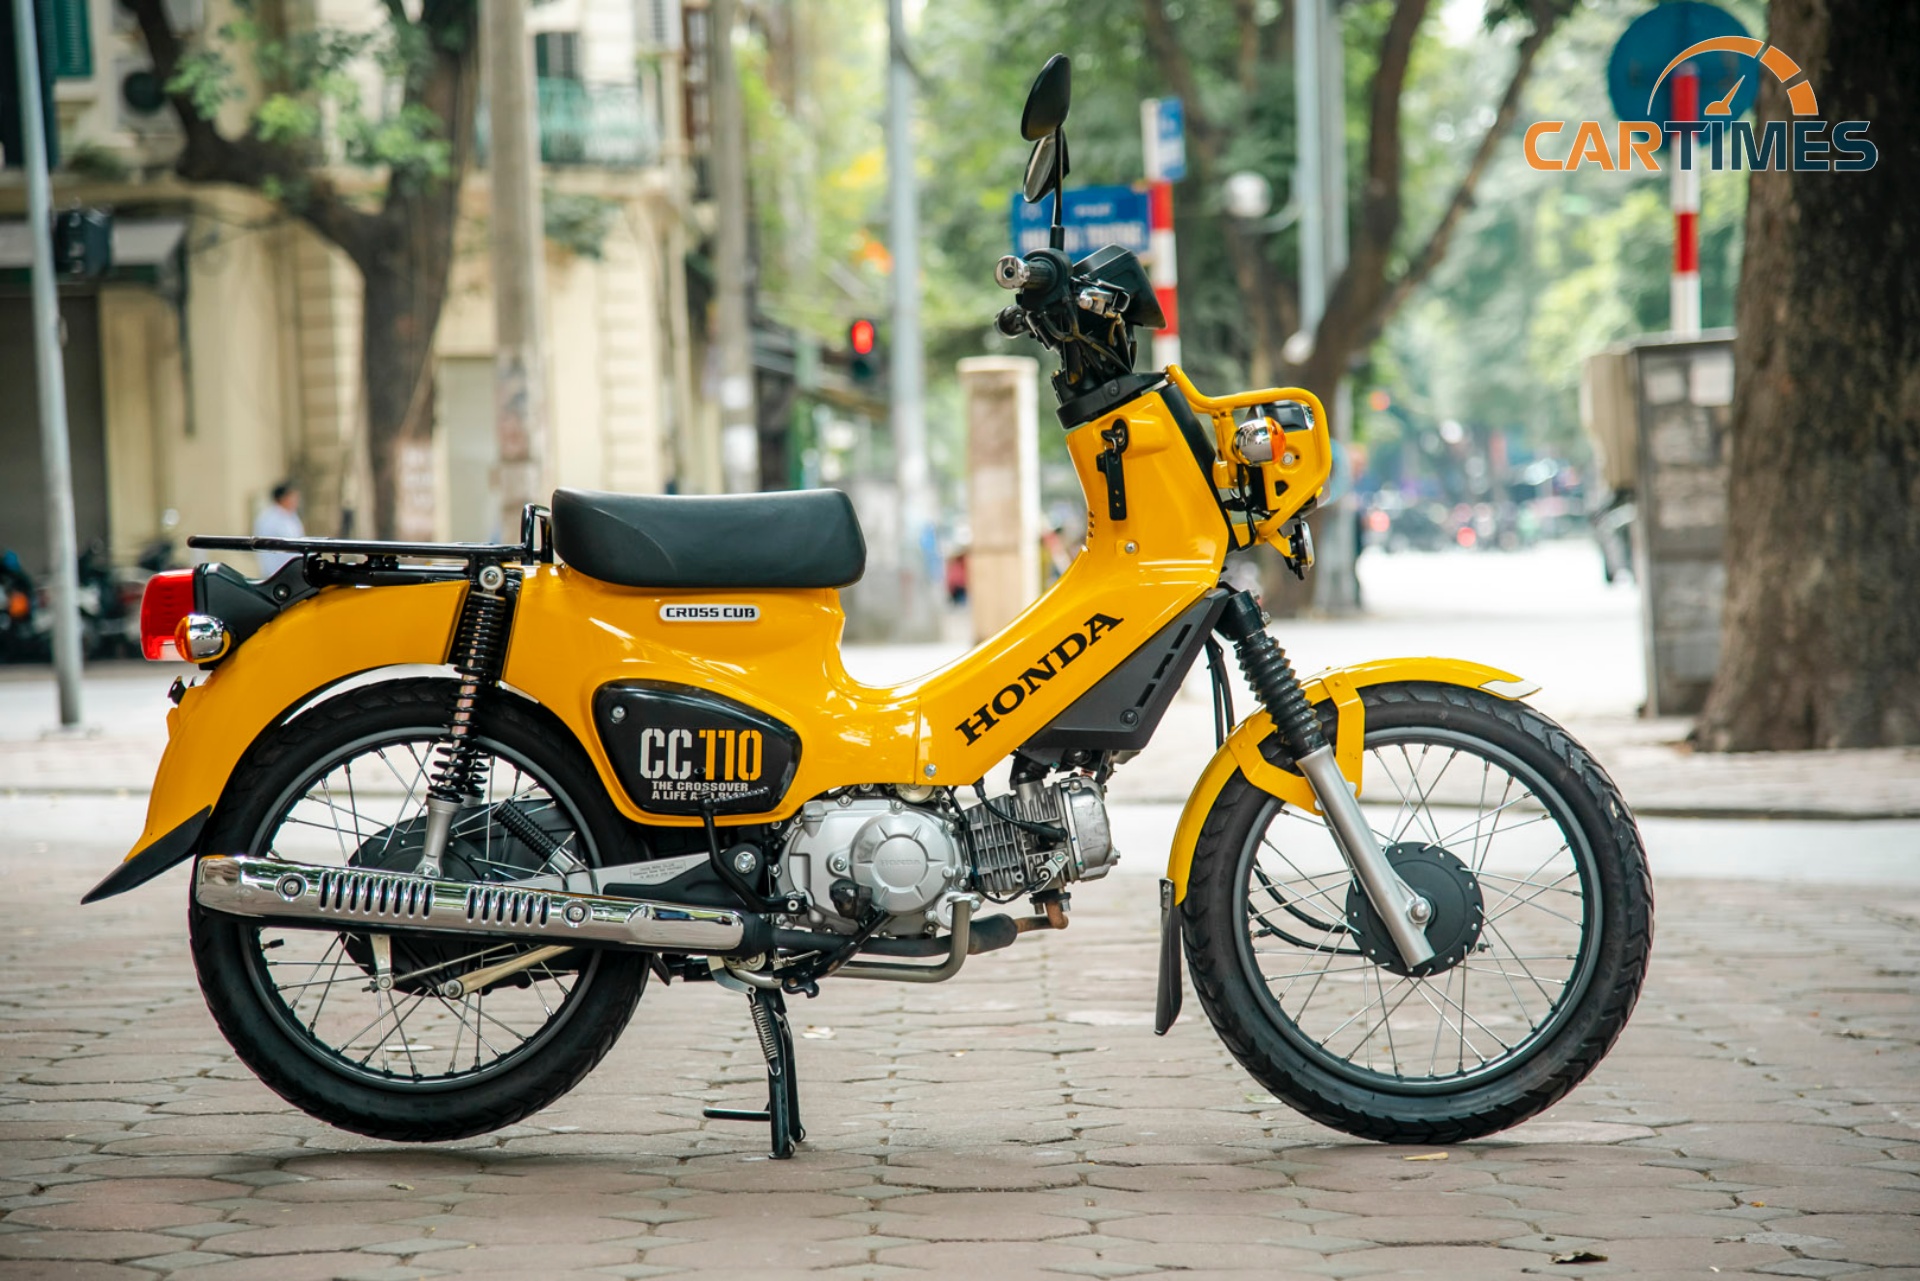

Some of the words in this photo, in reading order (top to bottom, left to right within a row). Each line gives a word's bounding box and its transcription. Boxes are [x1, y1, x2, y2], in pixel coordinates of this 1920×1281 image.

[666, 607, 719, 618] CROSS
[723, 607, 755, 618] CUB
[955, 613, 1124, 746] HONDA
[652, 781, 673, 791] THE
[677, 781, 749, 791] CROSSOVER
[651, 791, 660, 800] A
[663, 791, 687, 800] LIFE
